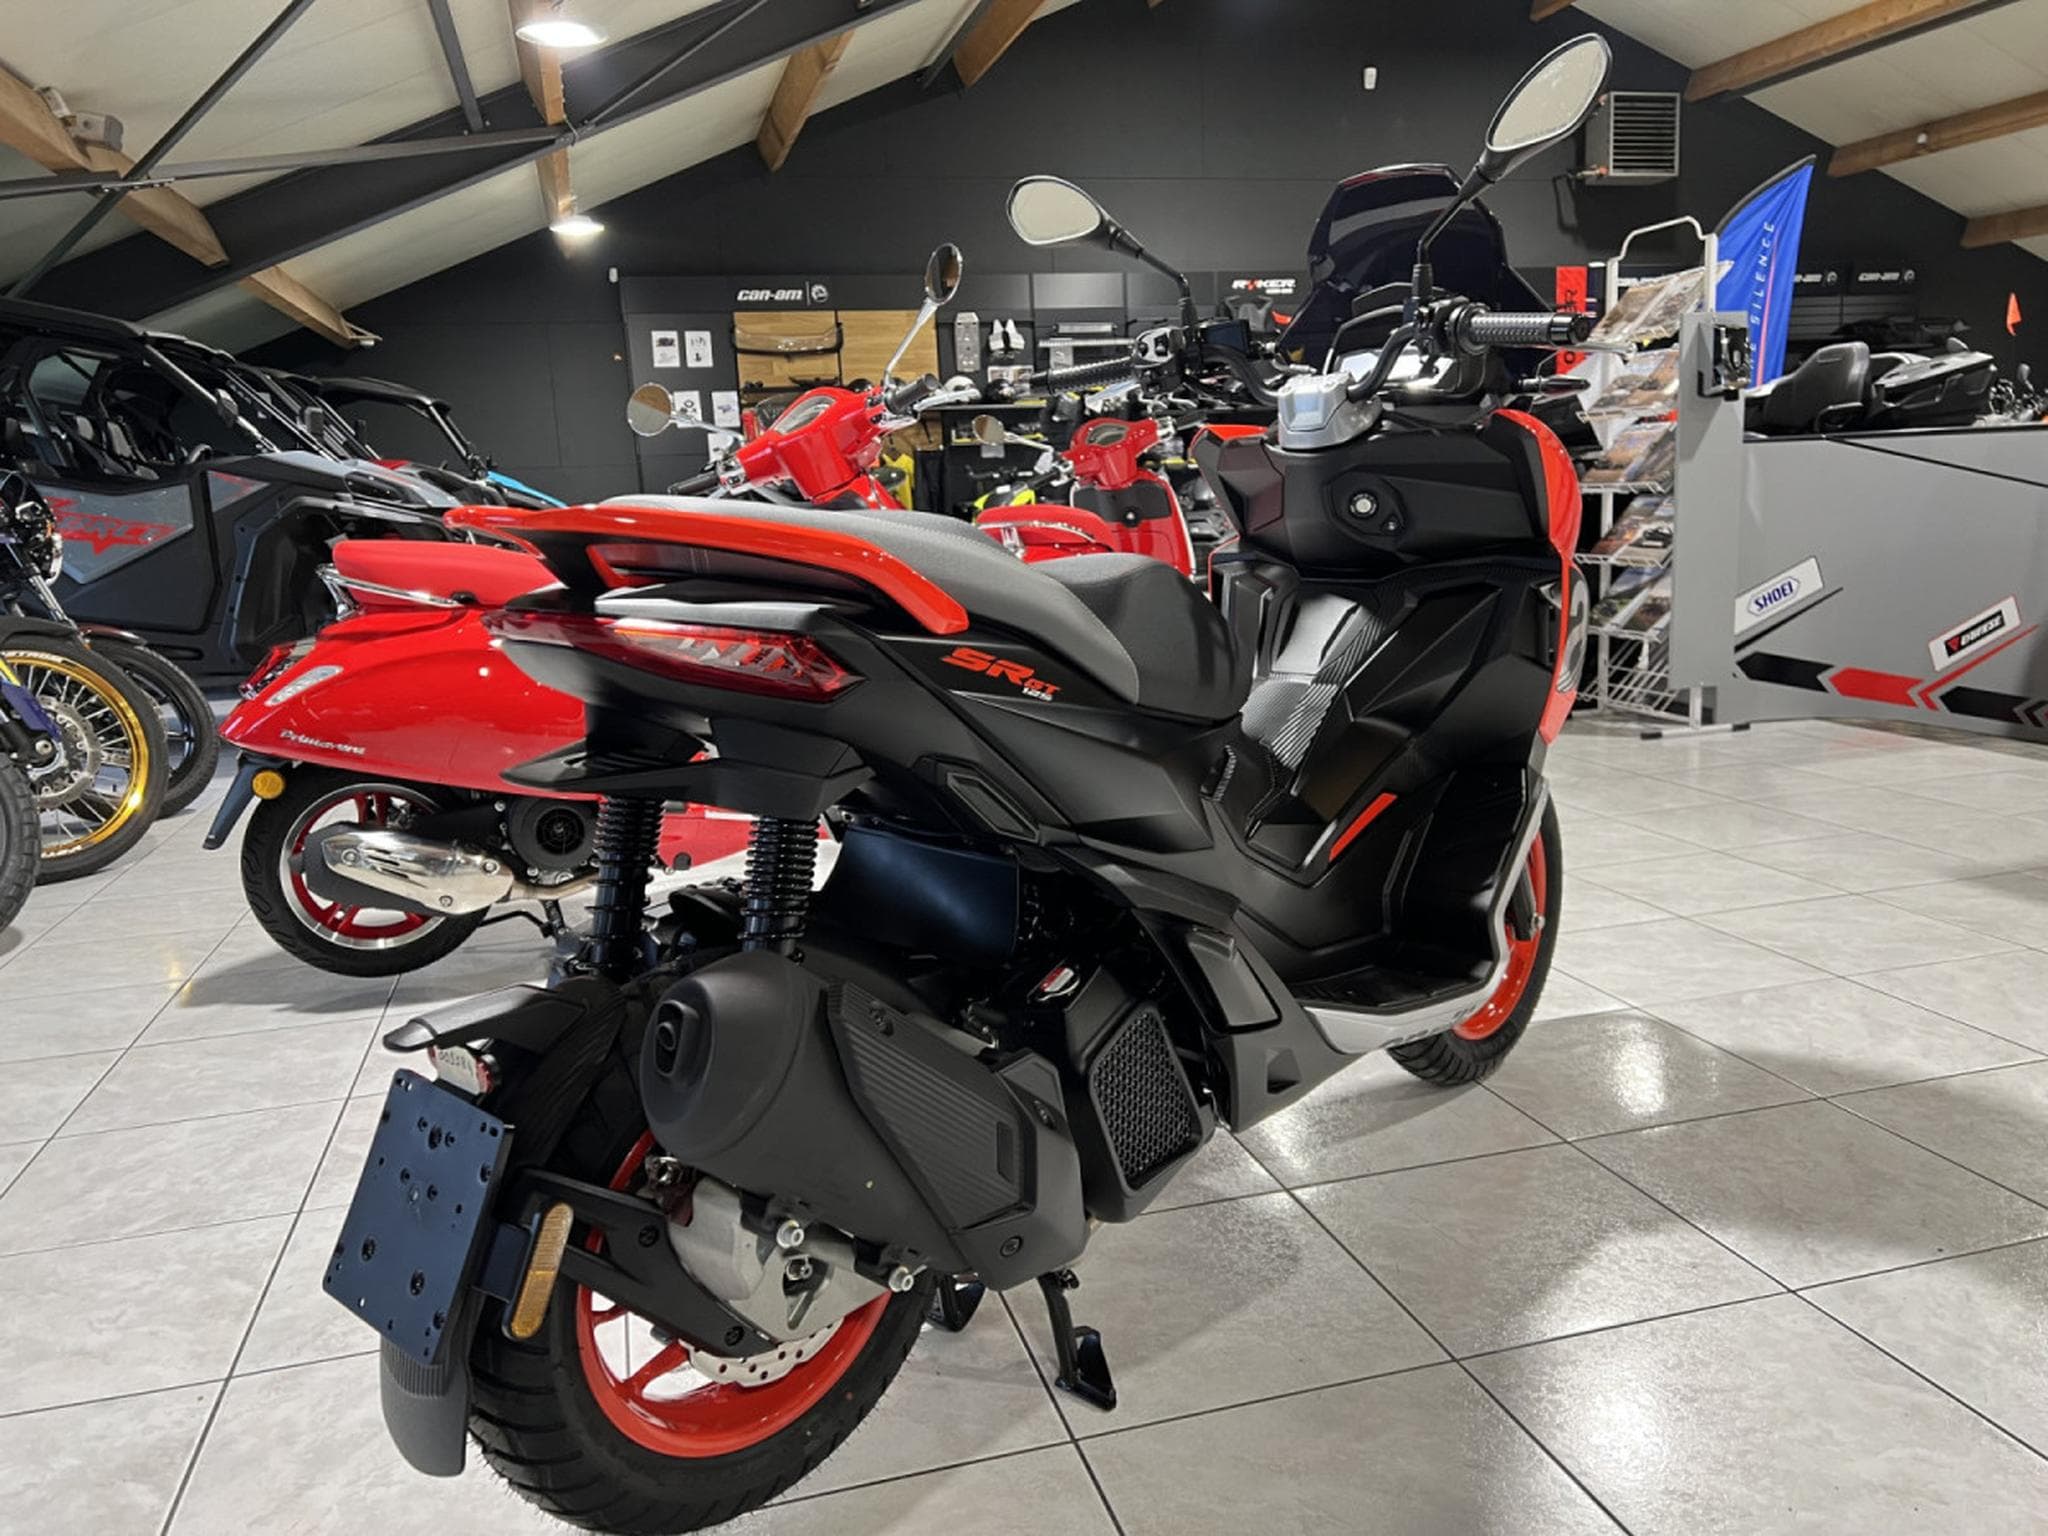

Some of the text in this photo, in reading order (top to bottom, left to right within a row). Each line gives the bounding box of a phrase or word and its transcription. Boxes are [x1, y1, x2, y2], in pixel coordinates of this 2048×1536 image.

[1750, 221, 1775, 326] SILENCE
[737, 289, 803, 301] can-am
[1754, 580, 1794, 612] SHOEI
[941, 646, 1061, 696] SR GT
